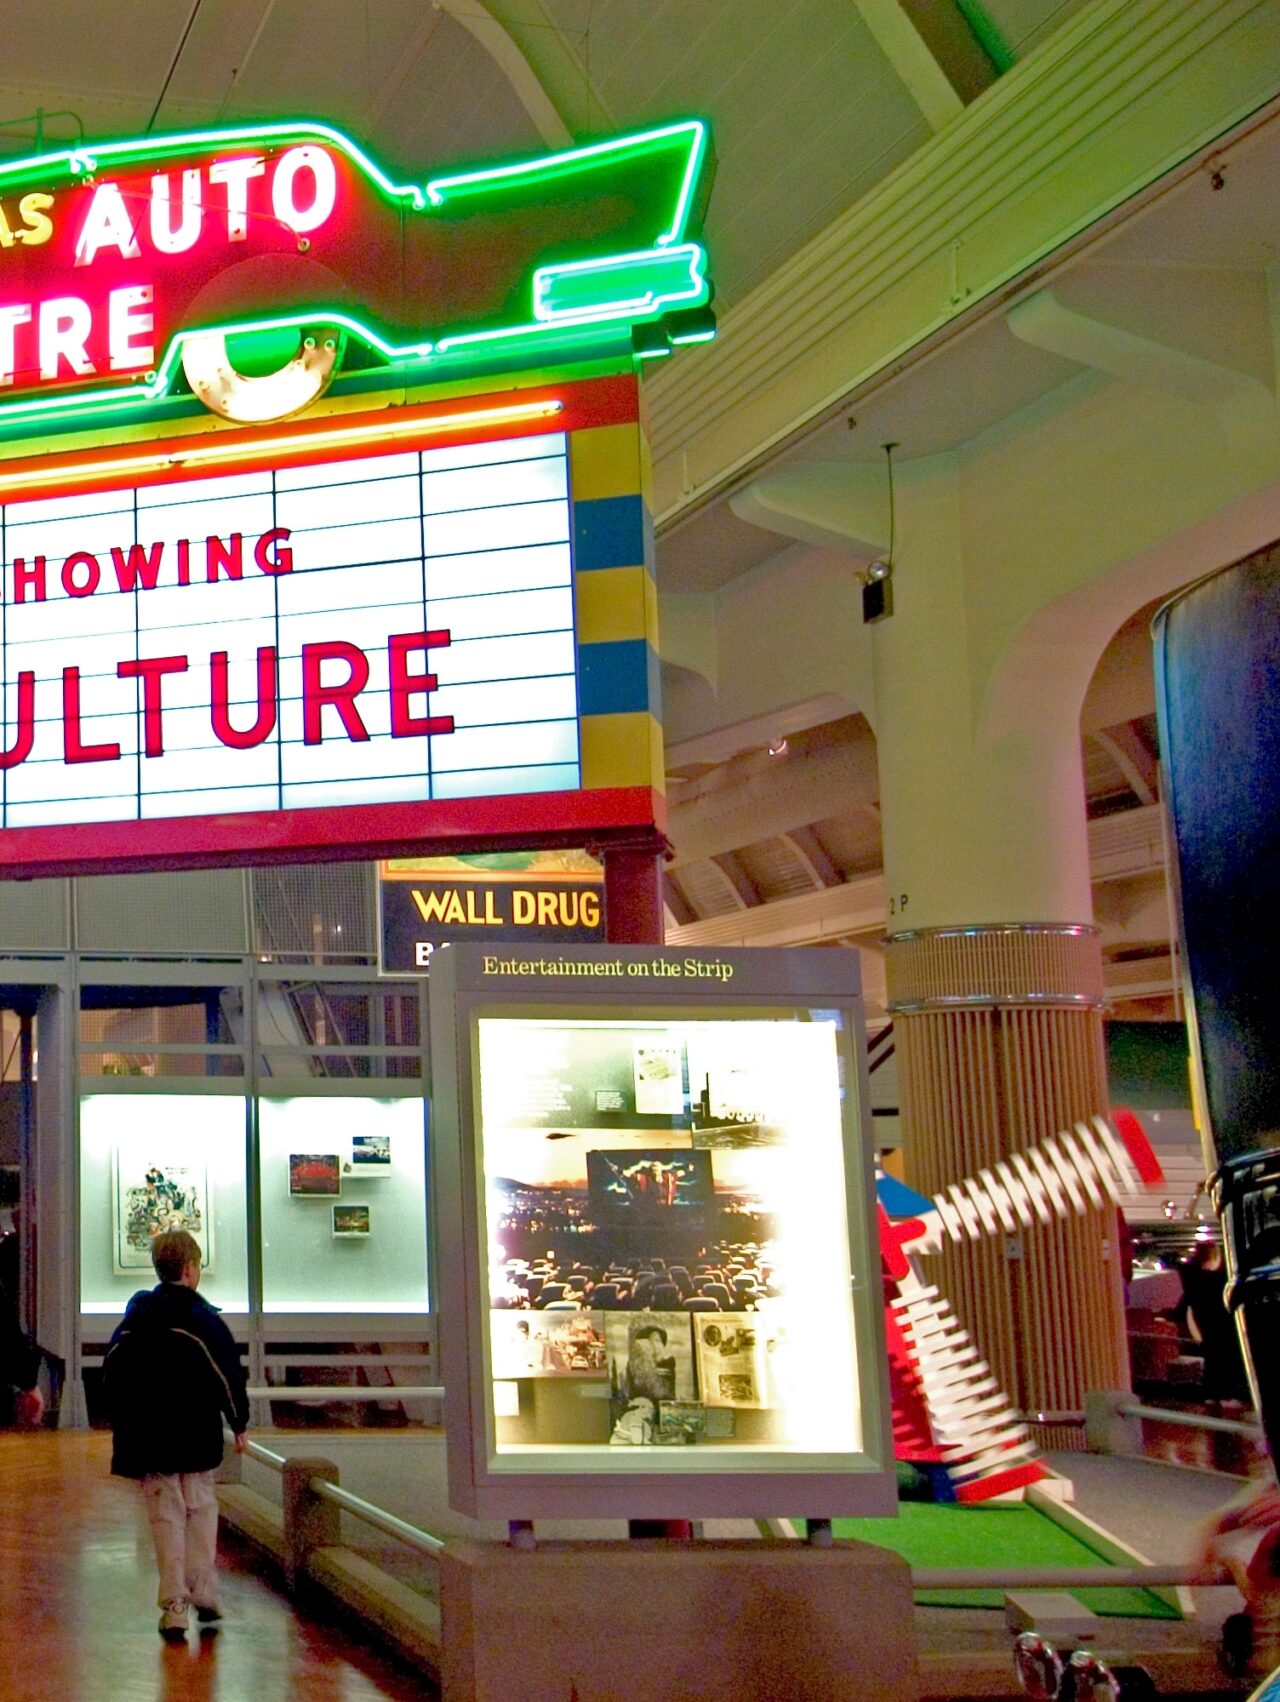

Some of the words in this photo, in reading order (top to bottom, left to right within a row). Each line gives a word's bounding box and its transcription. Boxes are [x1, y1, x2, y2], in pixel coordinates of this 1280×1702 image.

[72, 145, 337, 267] AUTO
[412, 889, 503, 925] WALL
[513, 891, 600, 927] DRUG
[482, 955, 624, 977] Entertainment
[627, 964, 649, 977] on
[651, 957, 681, 977] the
[684, 958, 733, 982] Strip
